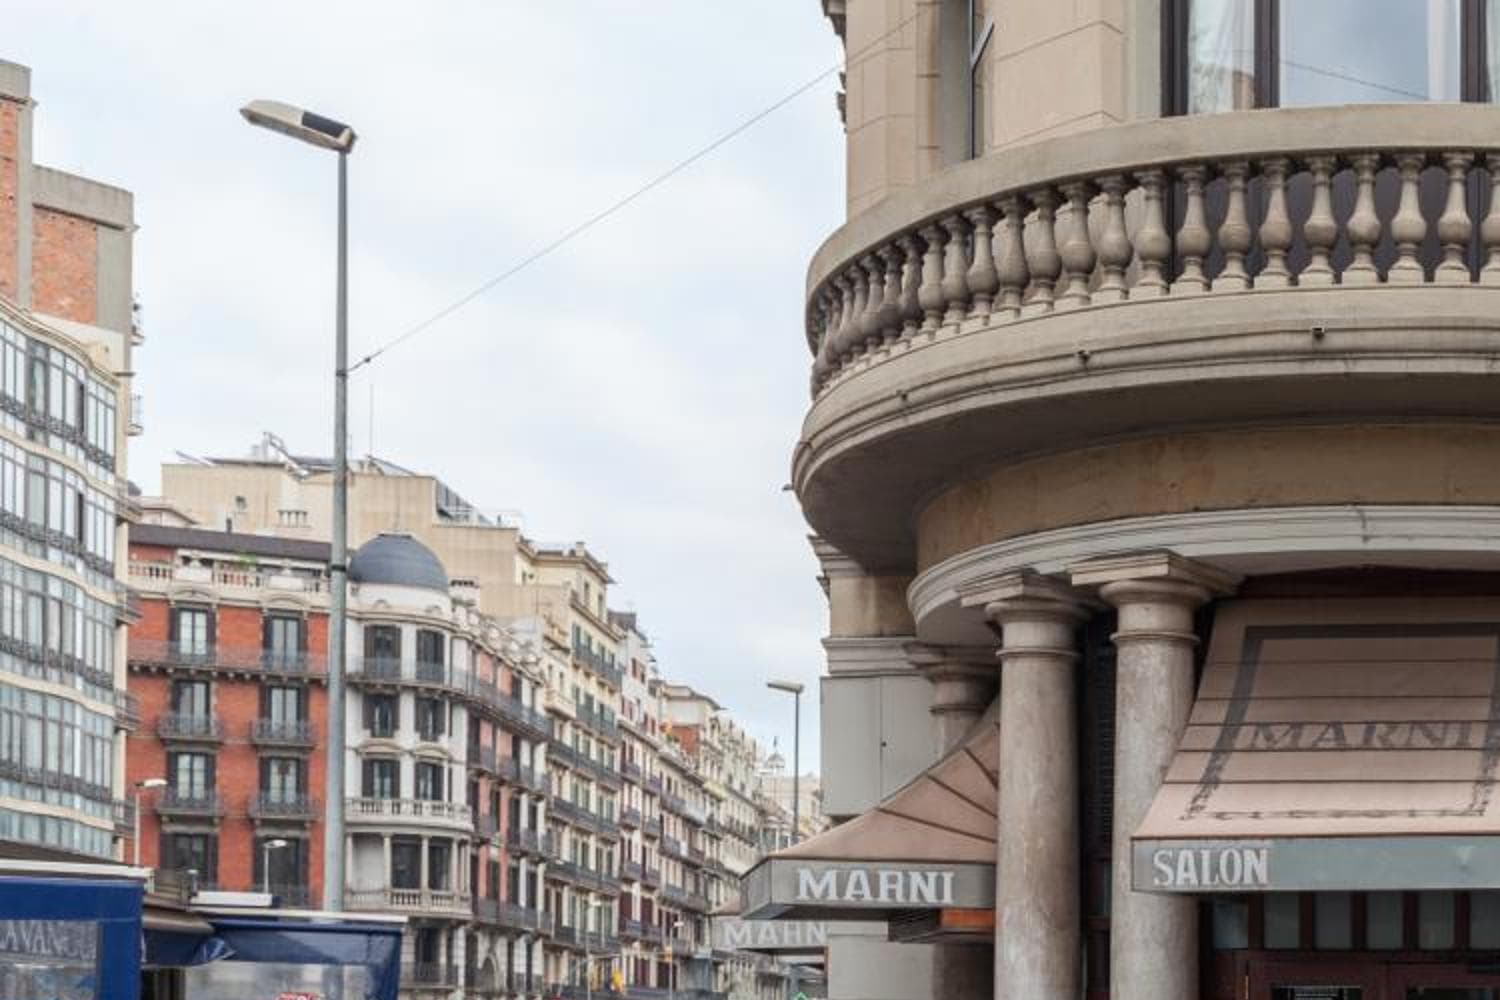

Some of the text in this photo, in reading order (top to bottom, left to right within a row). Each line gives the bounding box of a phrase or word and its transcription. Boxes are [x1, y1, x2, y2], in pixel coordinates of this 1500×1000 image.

[1248, 721, 1473, 749] MARNI
[1153, 848, 1269, 887] SALON
[797, 867, 955, 903] MARNI
[723, 920, 829, 945] MARN
